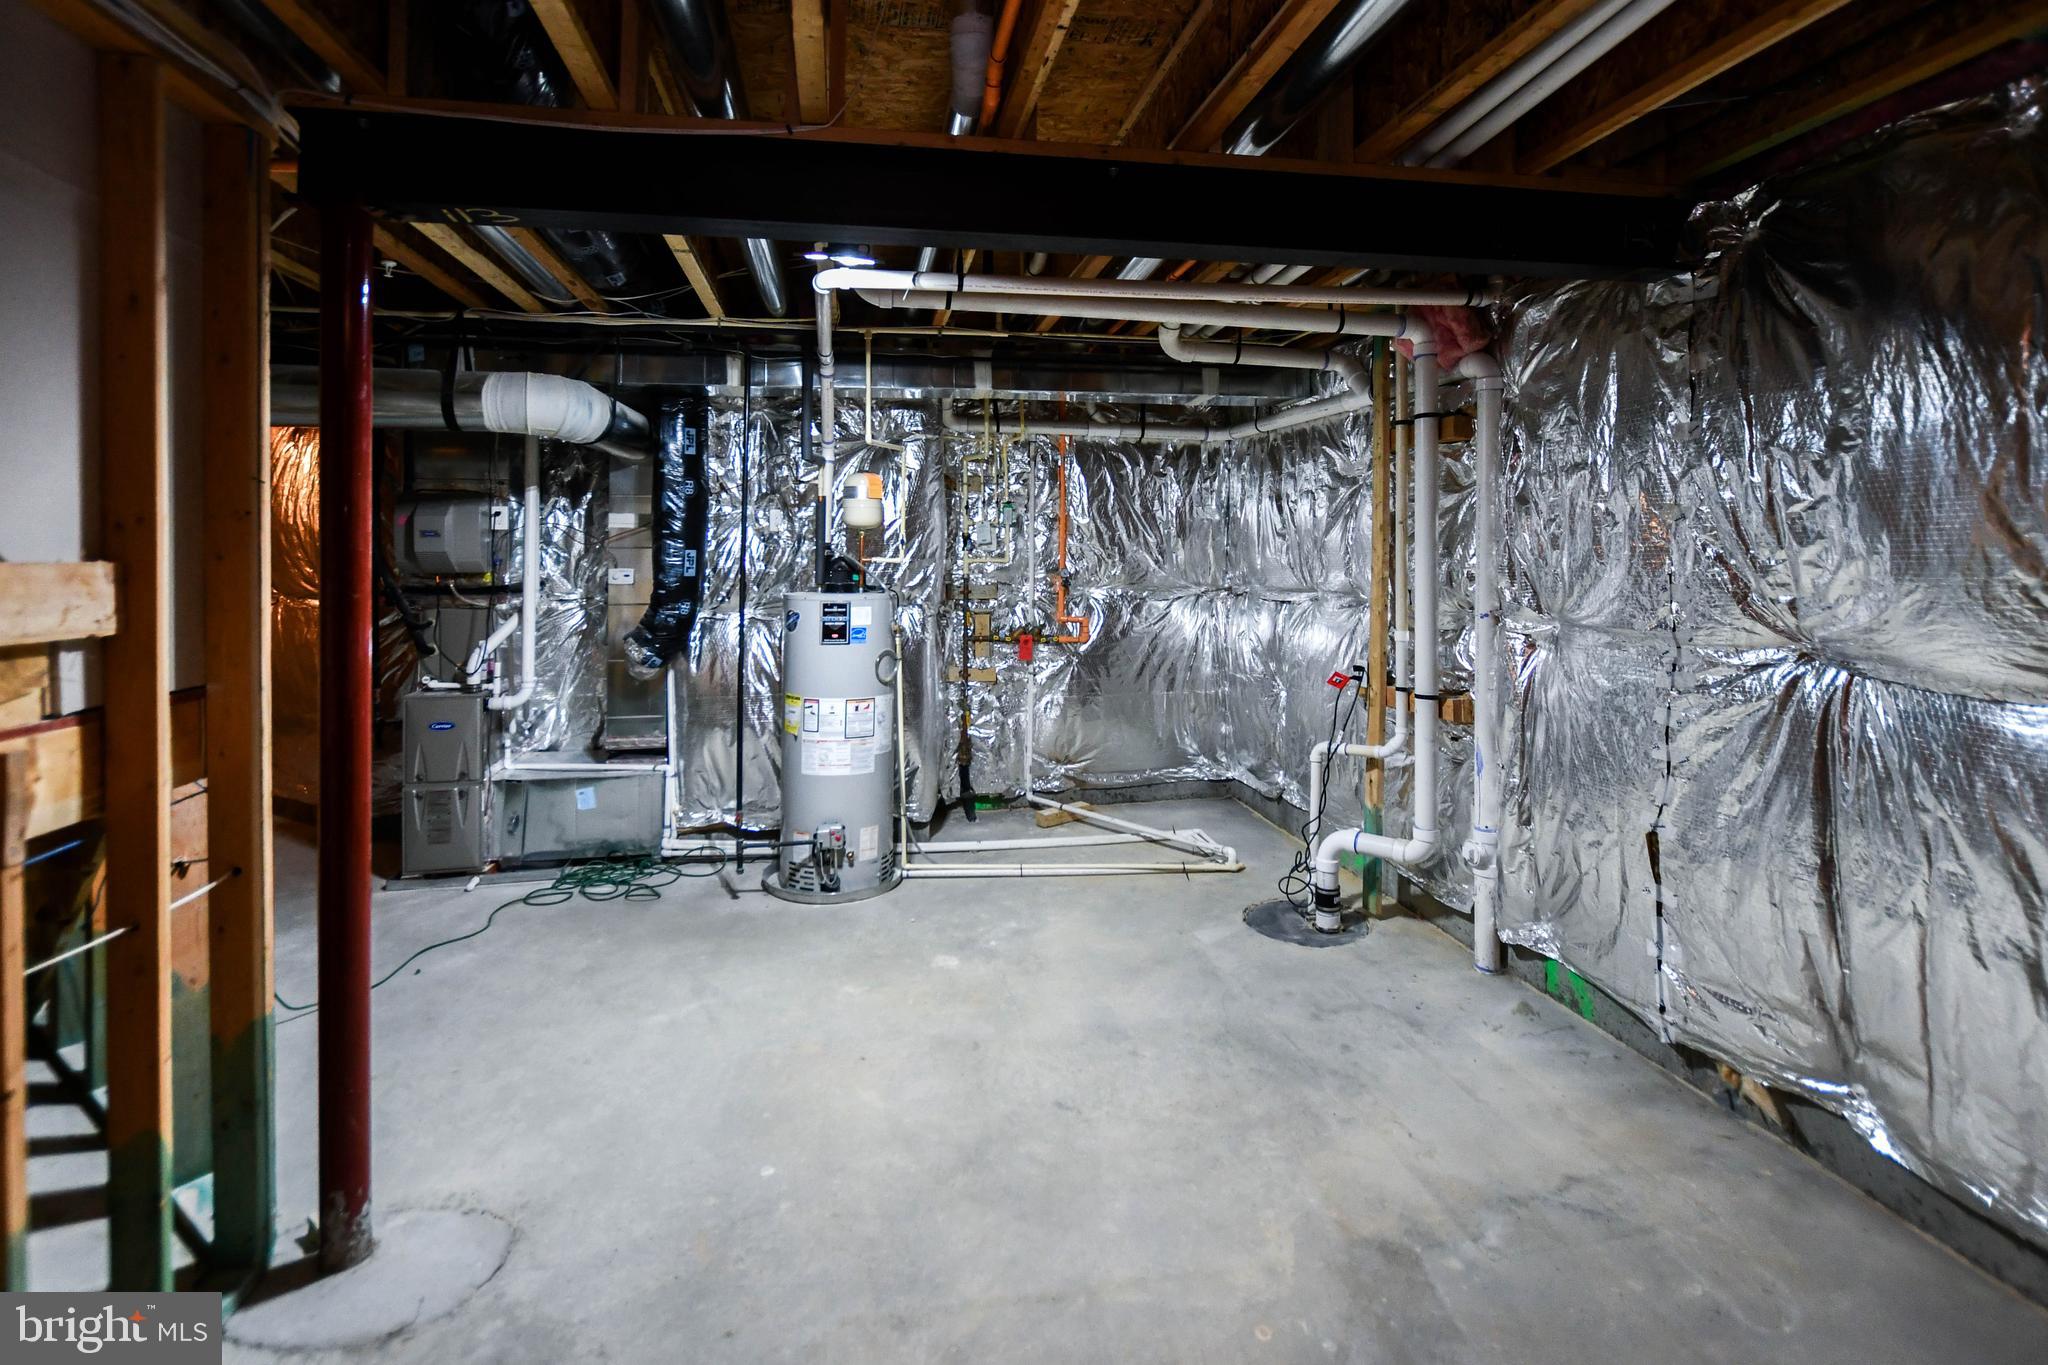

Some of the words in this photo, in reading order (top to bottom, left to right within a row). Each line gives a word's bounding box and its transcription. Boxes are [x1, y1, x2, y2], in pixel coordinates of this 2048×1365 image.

[685, 430, 695, 451] JPL
[684, 480, 695, 495] R8
[685, 552, 695, 574] JPL
